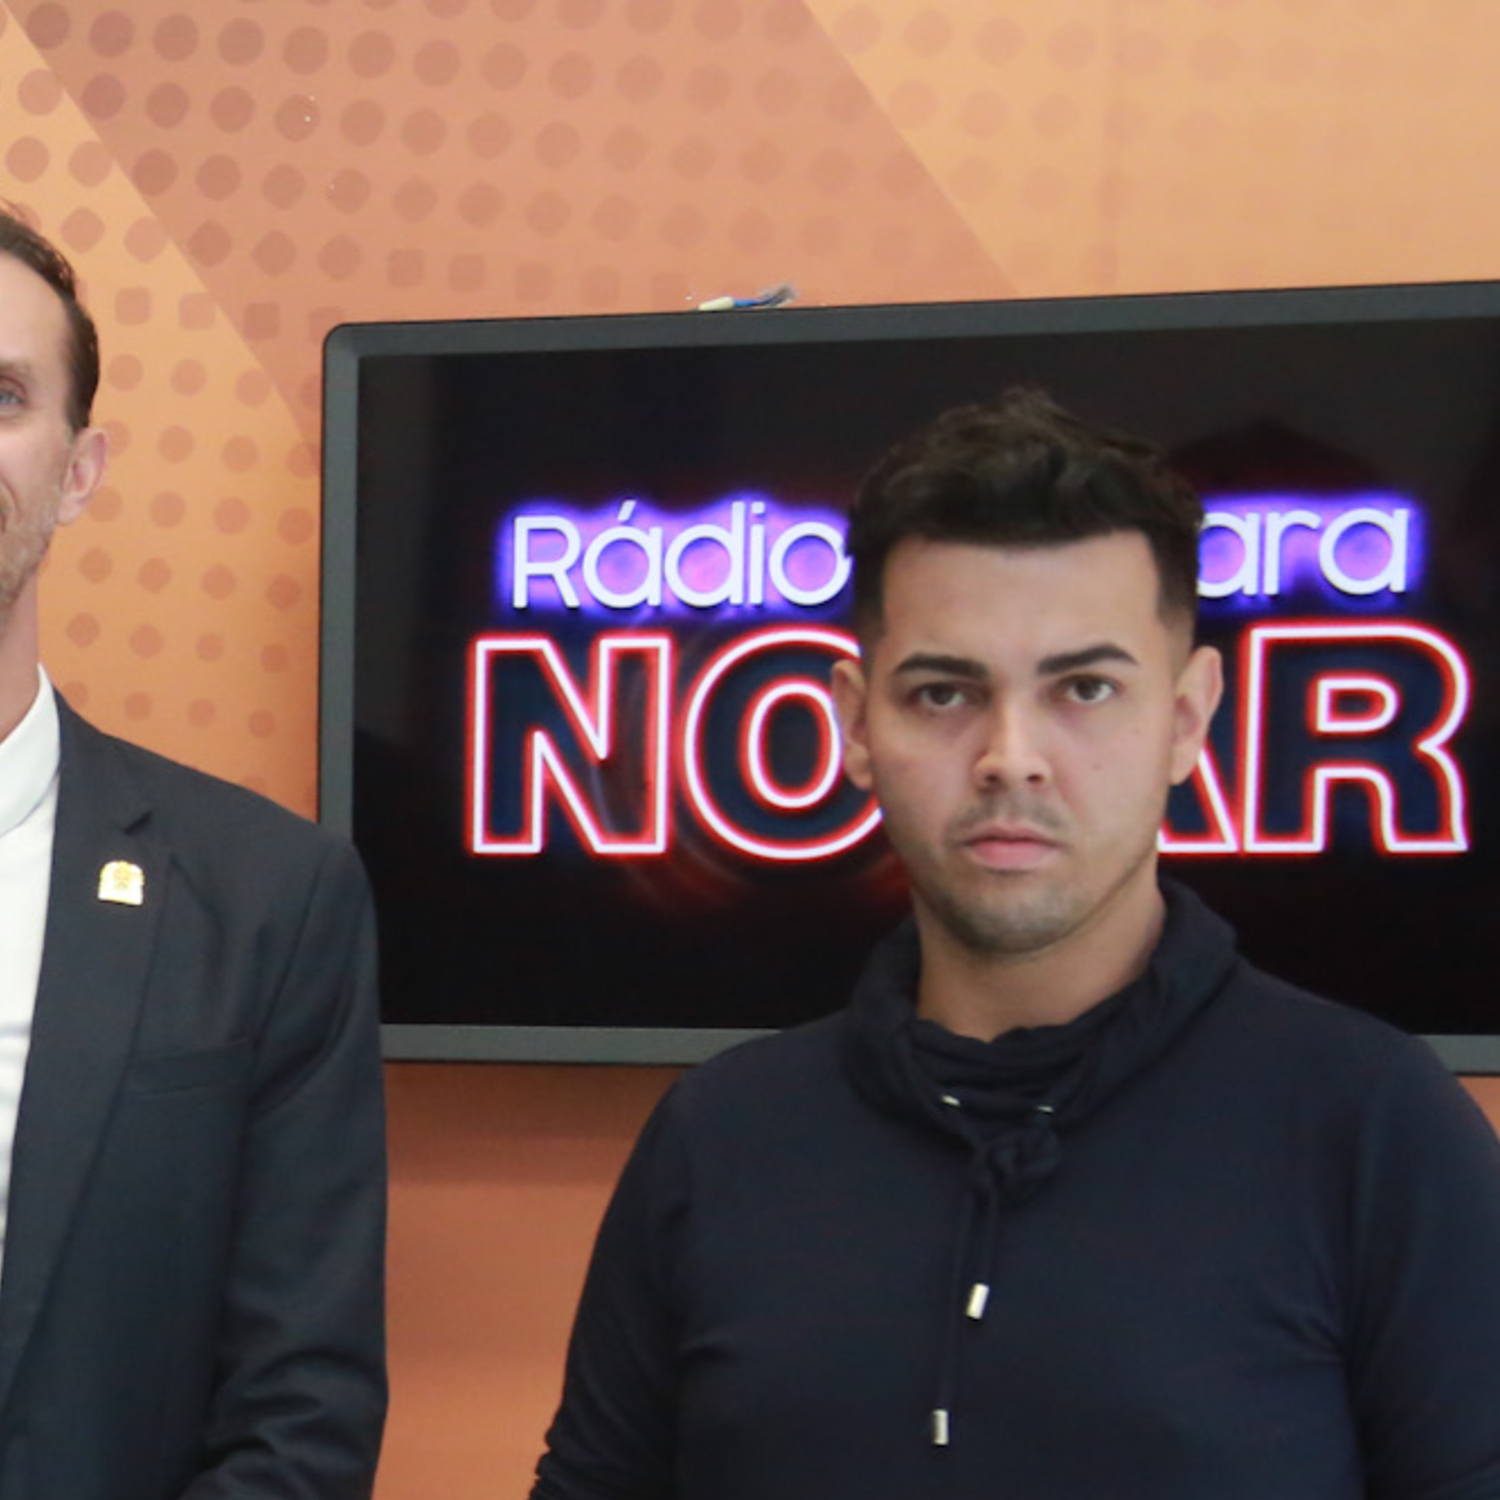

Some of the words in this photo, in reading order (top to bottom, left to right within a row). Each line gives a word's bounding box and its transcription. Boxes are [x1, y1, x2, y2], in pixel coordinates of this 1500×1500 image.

[512, 499, 853, 609] Rádio
[1196, 507, 1410, 599] ara
[470, 627, 884, 862] NO
